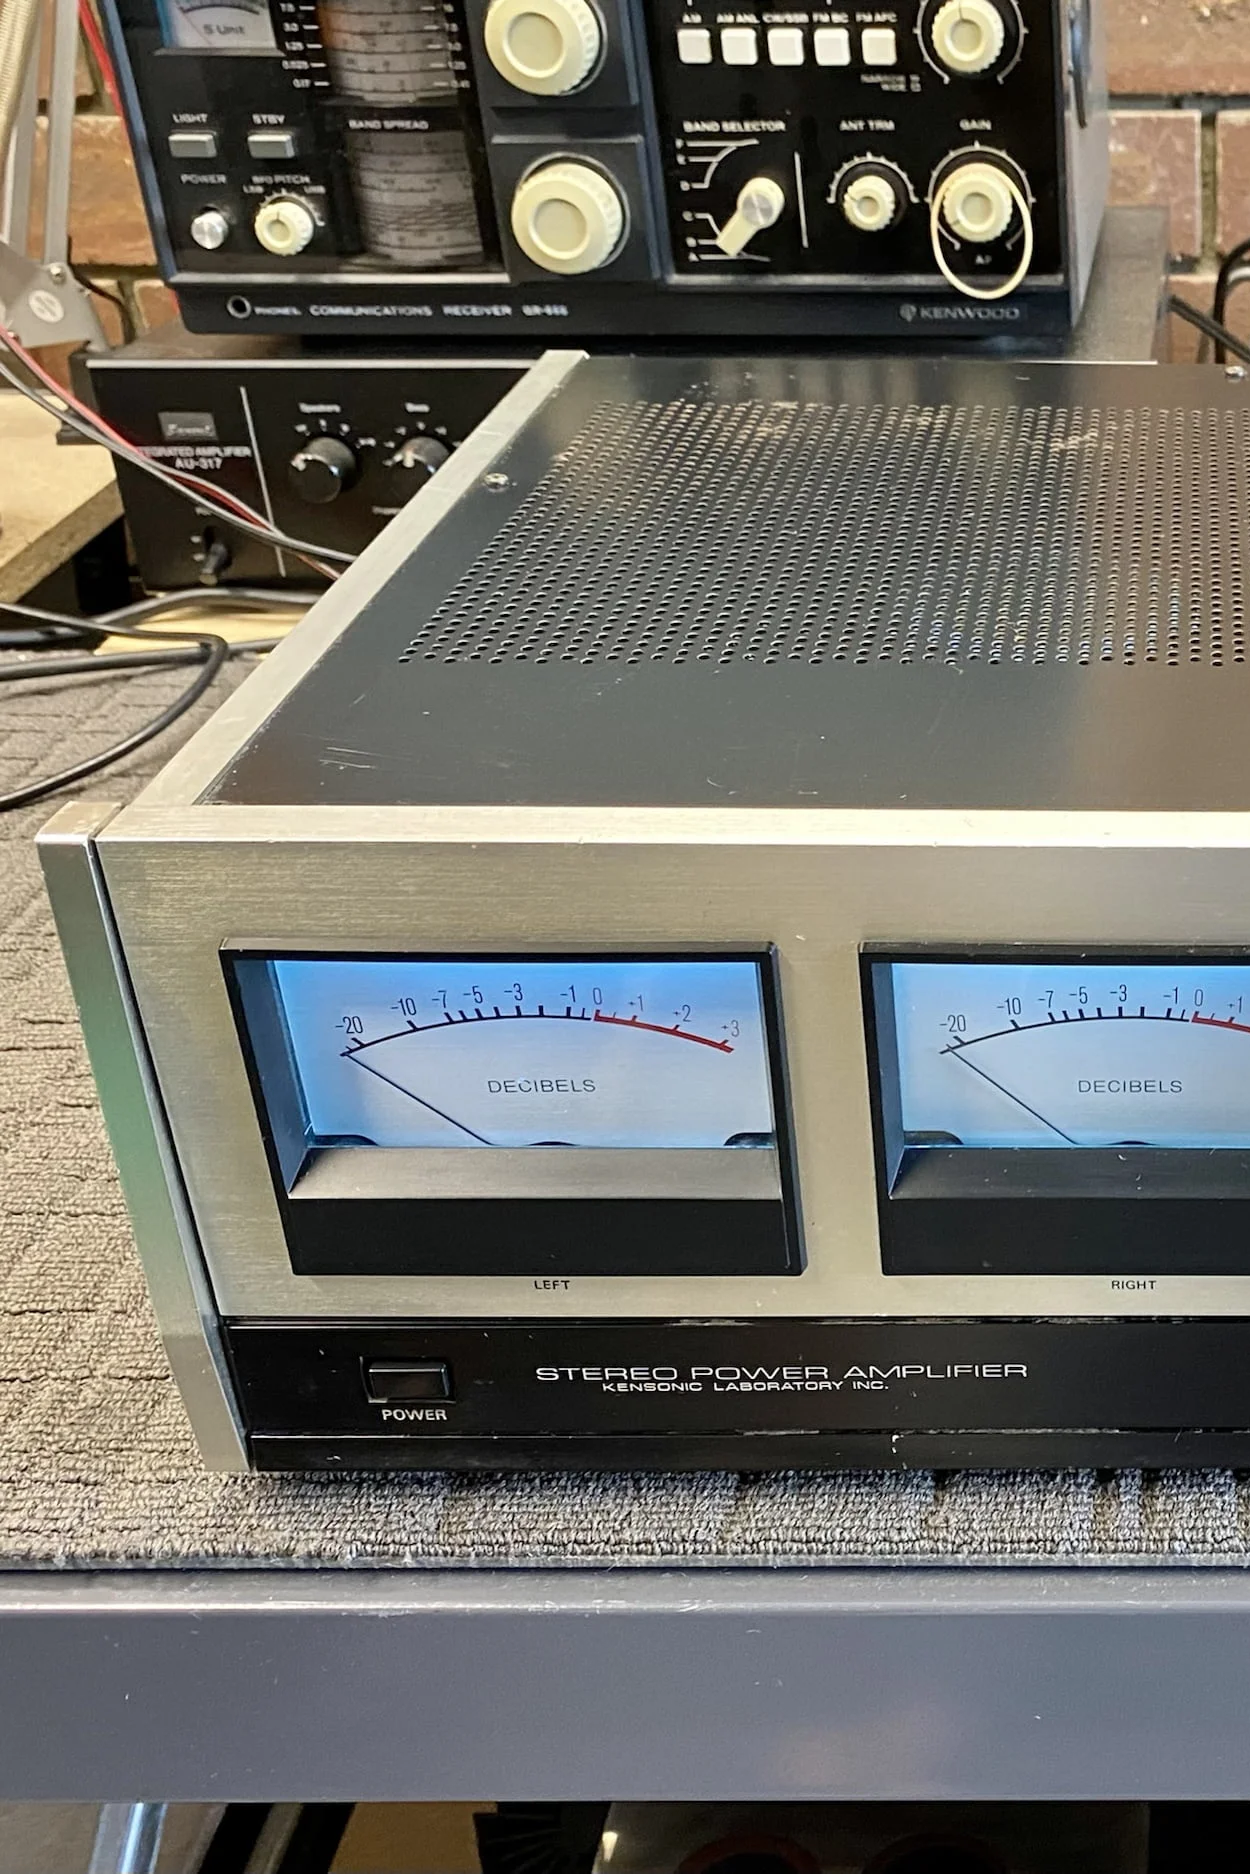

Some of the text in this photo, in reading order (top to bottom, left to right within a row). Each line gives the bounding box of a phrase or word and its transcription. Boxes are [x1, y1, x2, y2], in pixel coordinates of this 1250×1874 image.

[682, 12, 702, 24] AM
[716, 12, 735, 24] AM
[812, 12, 830, 24] FM
[855, 12, 874, 24] FM
[172, 113, 208, 124] LIGHT
[252, 114, 286, 125] STBY
[348, 119, 430, 130] BAND SPREAD
[682, 120, 787, 133] BAND SELECTOR
[839, 120, 866, 132] ANT
[958, 119, 993, 131] GAIN
[180, 173, 227, 185] POWER
[273, 173, 311, 185] PITCH
[309, 304, 433, 317] COMMUNICATIONS
[442, 304, 512, 317] RECEIVER
[919, 307, 1021, 320] KENWOOD
[195, 445, 252, 458] AMPLIFIER
[174, 457, 223, 470] AU-317
[334, 982, 741, 1038] -20 -10 -7 -5 -3 -1 0 +1 +2 +3
[938, 1014, 967, 1033] -20
[996, 996, 1023, 1016] -10
[1037, 989, 1055, 1009] -7
[1068, 985, 1088, 1005] -5
[1109, 983, 1128, 1002] -3
[1163, 986, 1179, 1005] -1
[1193, 988, 1204, 1007] 0
[1227, 995, 1243, 1014] +1
[487, 1078, 597, 1094] DECIBELS
[1077, 1079, 1184, 1094] DECIBELS
[533, 1279, 571, 1291] LEFT
[1111, 1279, 1157, 1290] RIGHT
[536, 1363, 1028, 1381] STEREO POWER AMPLIFIER
[602, 1379, 889, 1393] KENSONIC LABORATORY INC.
[381, 1408, 448, 1422] POWER
